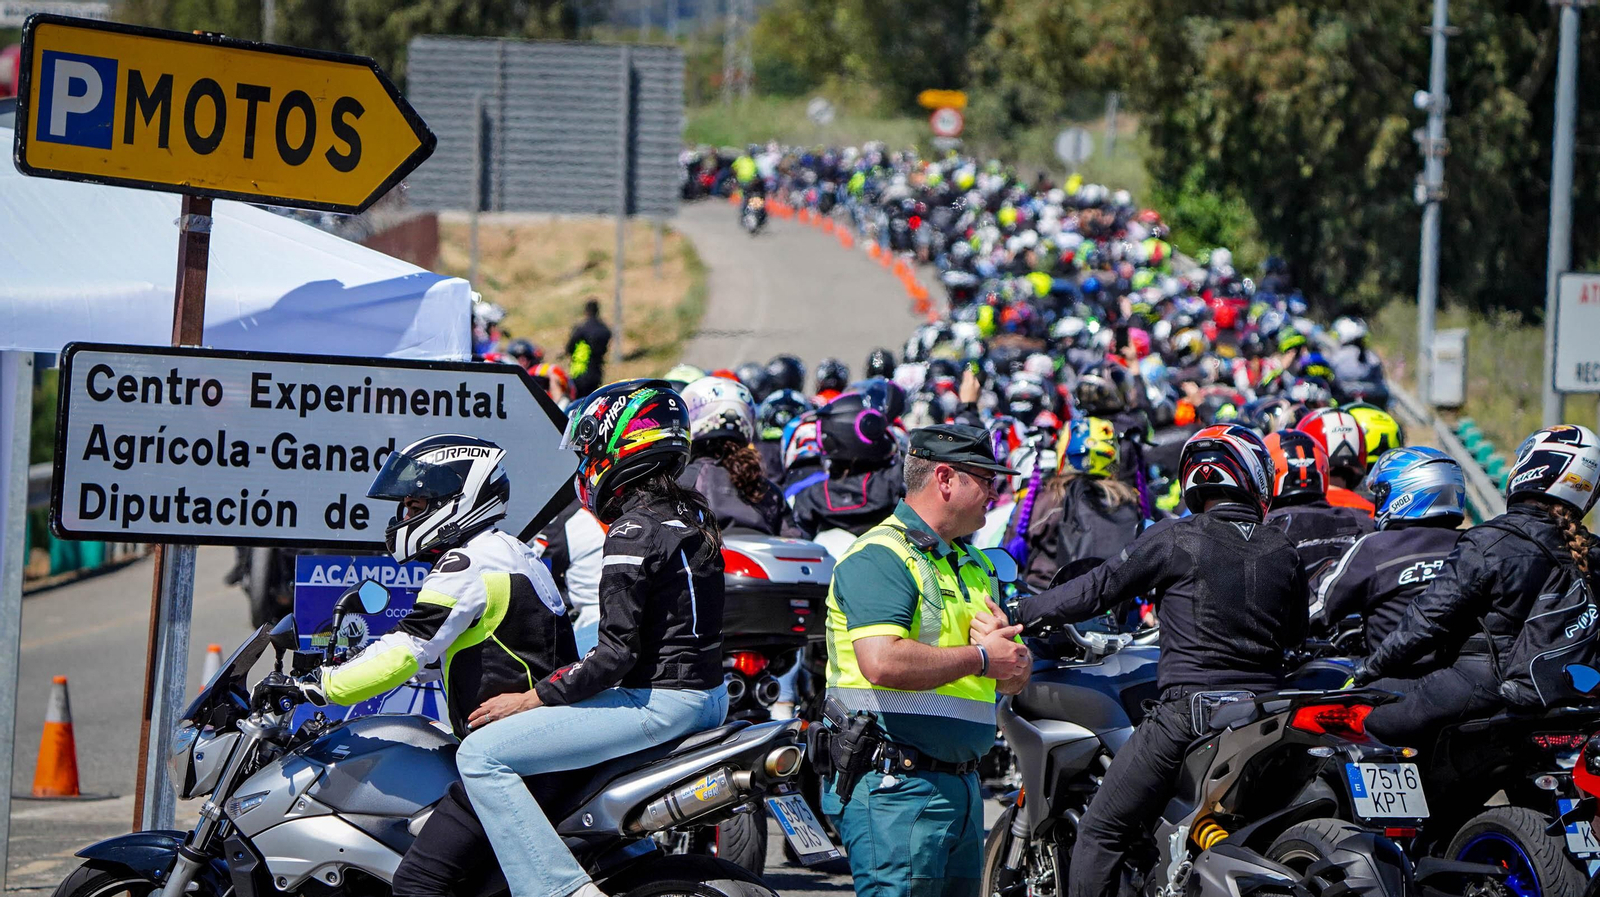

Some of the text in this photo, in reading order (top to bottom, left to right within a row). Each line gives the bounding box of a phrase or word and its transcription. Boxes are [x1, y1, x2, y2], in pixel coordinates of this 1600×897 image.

[49, 58, 366, 173] P MOTOS
[86, 363, 508, 420] Centro Experimental
[599, 395, 627, 443] SHIRO
[83, 424, 396, 474] Agrícola-Ganad
[79, 482, 369, 531] Diputación de
[1391, 494, 1411, 511] SHOEI
[309, 564, 429, 586] ACAMPAD
[1354, 783, 1362, 792] E
[1366, 768, 1418, 790] 7516
[779, 799, 813, 824] 9975
[1371, 792, 1408, 813] KPT
[794, 825, 822, 849] DXS
